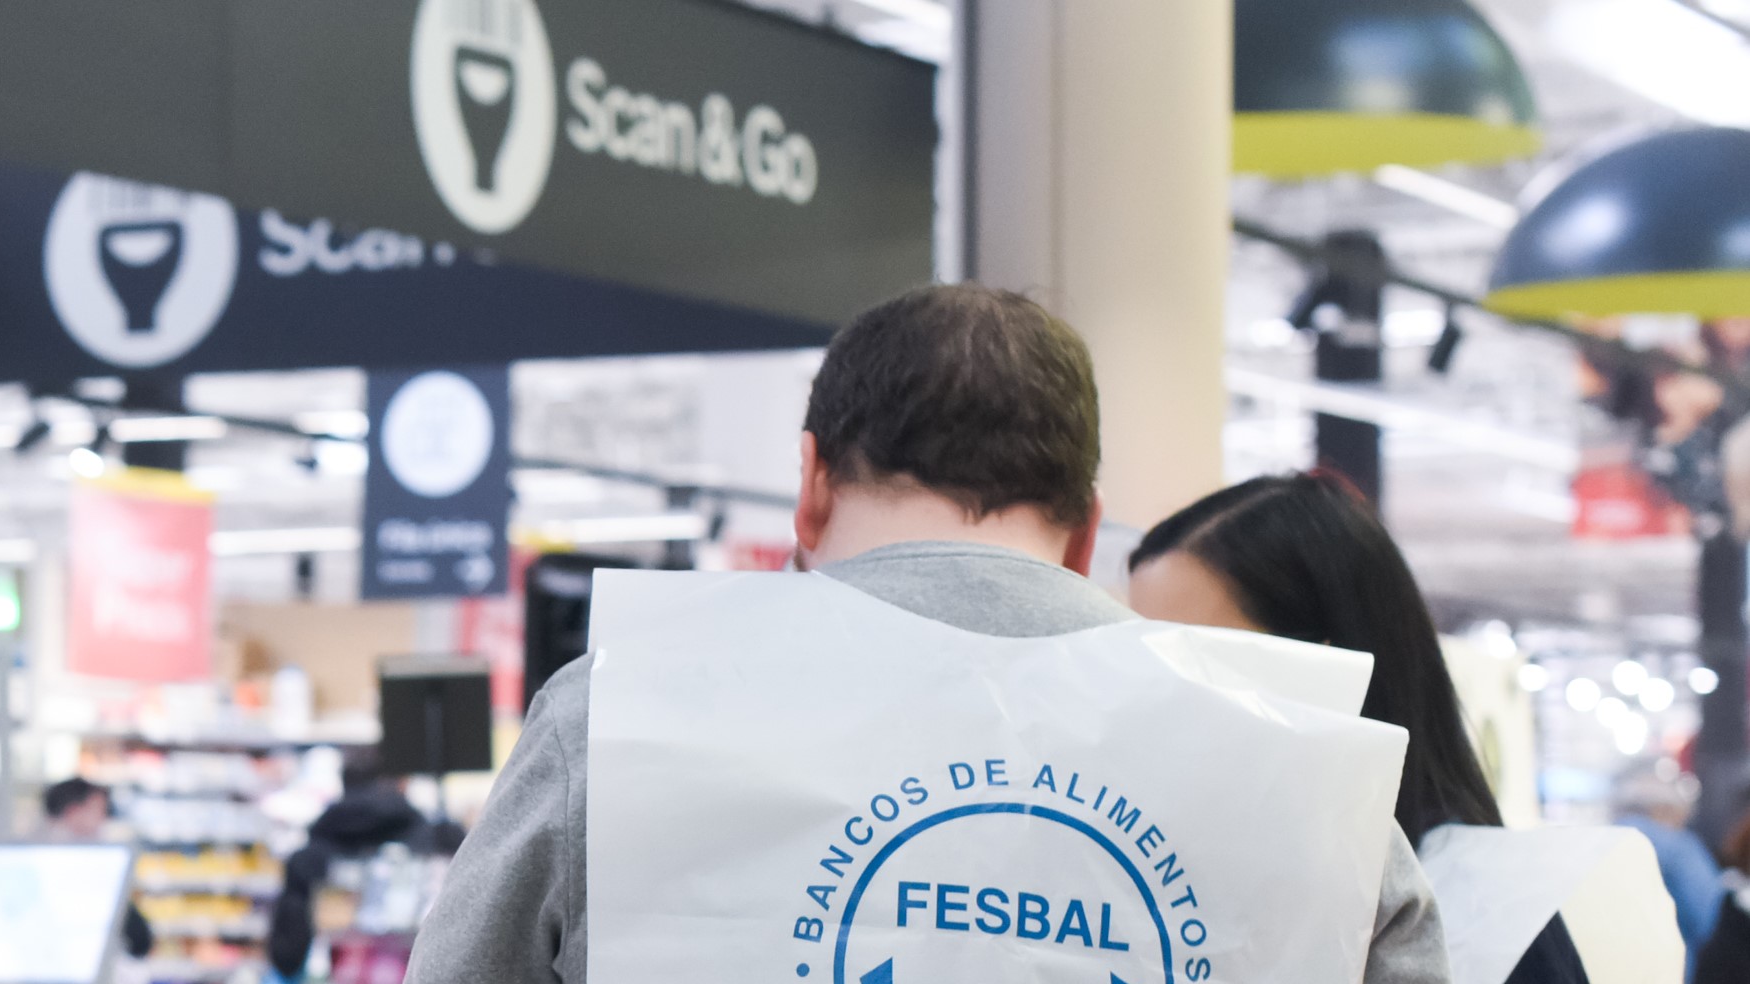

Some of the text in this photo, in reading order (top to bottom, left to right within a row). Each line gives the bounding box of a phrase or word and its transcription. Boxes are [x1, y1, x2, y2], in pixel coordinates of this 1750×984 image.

[792, 758, 1211, 983] BANCOS DE ALIMENTOS
[896, 880, 1130, 951] FESBAL
